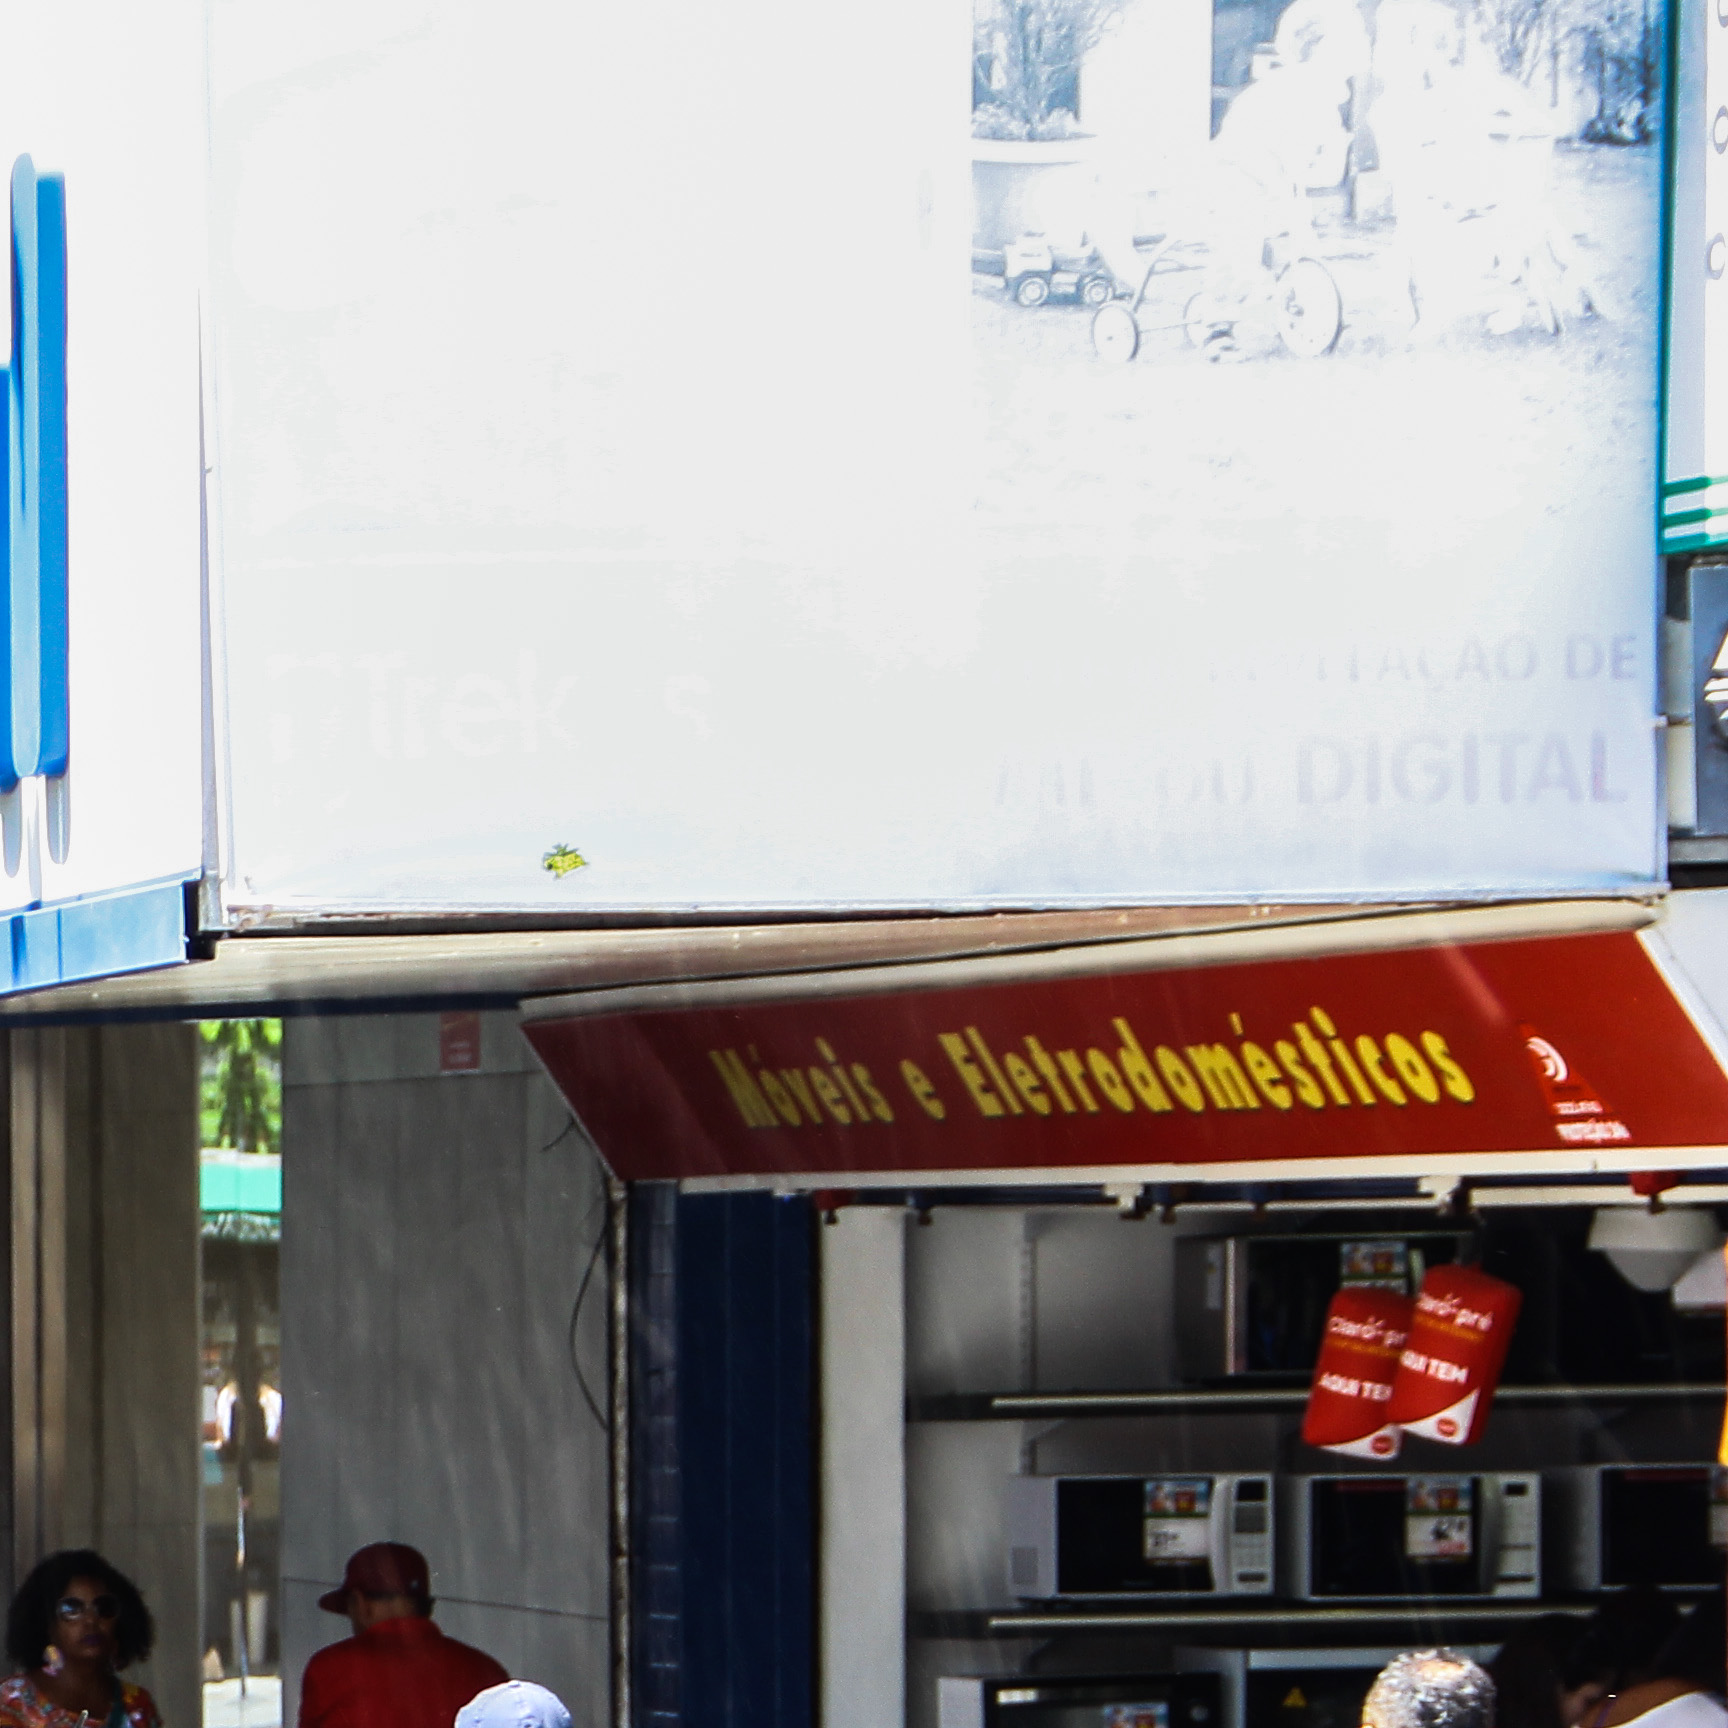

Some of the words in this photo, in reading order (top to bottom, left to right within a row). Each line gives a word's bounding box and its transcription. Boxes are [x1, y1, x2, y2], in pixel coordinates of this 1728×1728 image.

[1565, 632, 1638, 681] DE
[1295, 728, 1629, 806] DIGITAL
[709, 1036, 895, 1129] Móveis
[899, 1056, 945, 1119] e
[939, 1004, 1477, 1118] Eletrodomésticos
[1427, 1357, 1470, 1385] TEM
